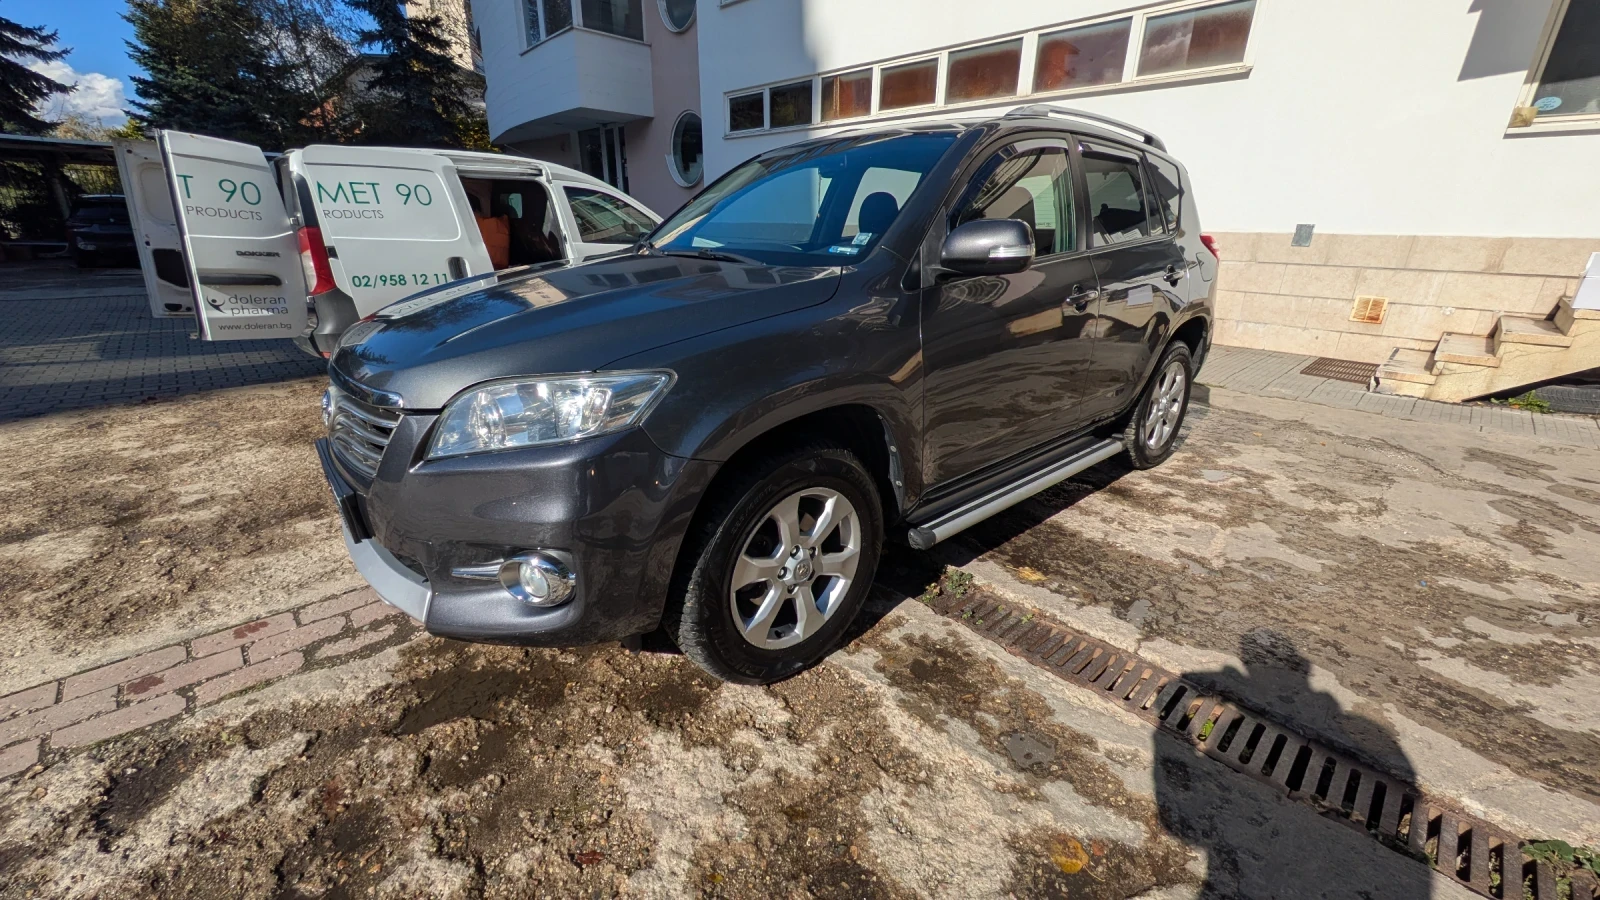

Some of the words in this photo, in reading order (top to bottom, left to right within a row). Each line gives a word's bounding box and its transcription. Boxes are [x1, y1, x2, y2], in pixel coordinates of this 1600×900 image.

[218, 178, 262, 206] 90
[316, 180, 381, 205] MET
[395, 183, 433, 207] 90
[185, 205, 263, 221] PRODUCTS
[322, 209, 385, 219] RODUCTS
[351, 273, 408, 289] 02/958
[411, 273, 430, 286] 12
[228, 294, 287, 305] doleran
[230, 305, 289, 317] pharma
[217, 322, 293, 332] www.doleran.bg
